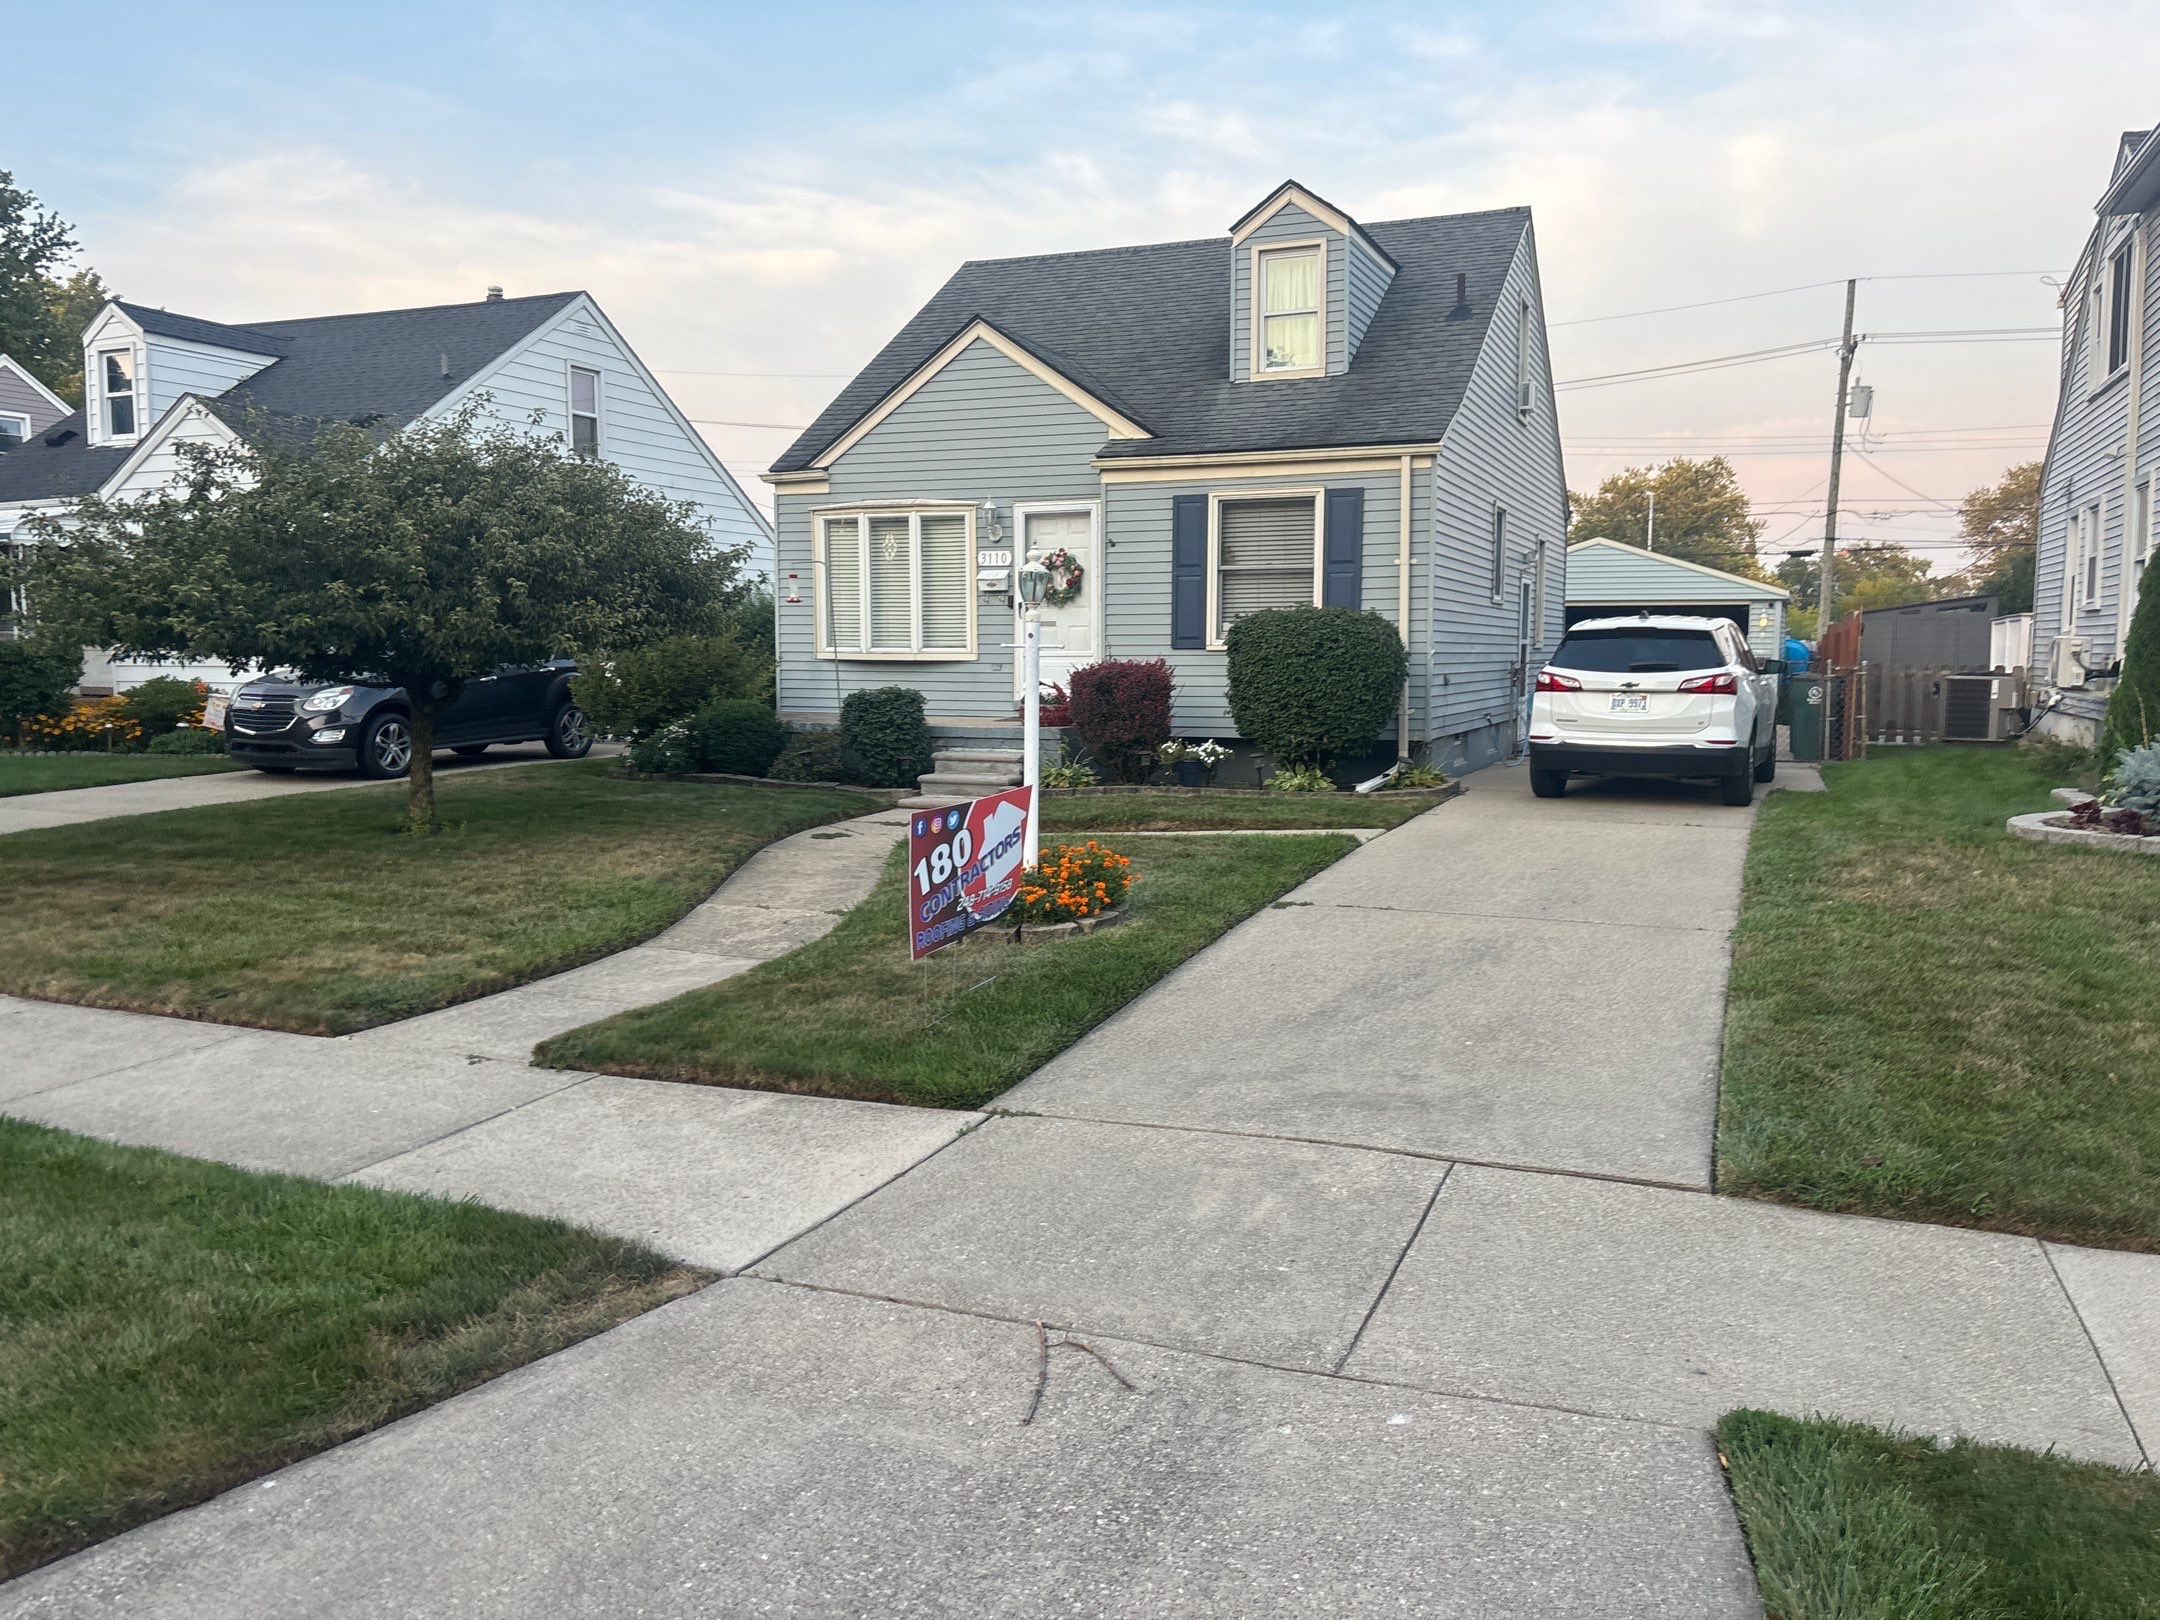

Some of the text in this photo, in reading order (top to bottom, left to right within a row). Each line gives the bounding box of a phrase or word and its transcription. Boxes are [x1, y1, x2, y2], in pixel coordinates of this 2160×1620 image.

[980, 552, 1007, 565] 3110
[913, 828, 973, 896] 180
[919, 825, 1022, 923] CONTRACTORS
